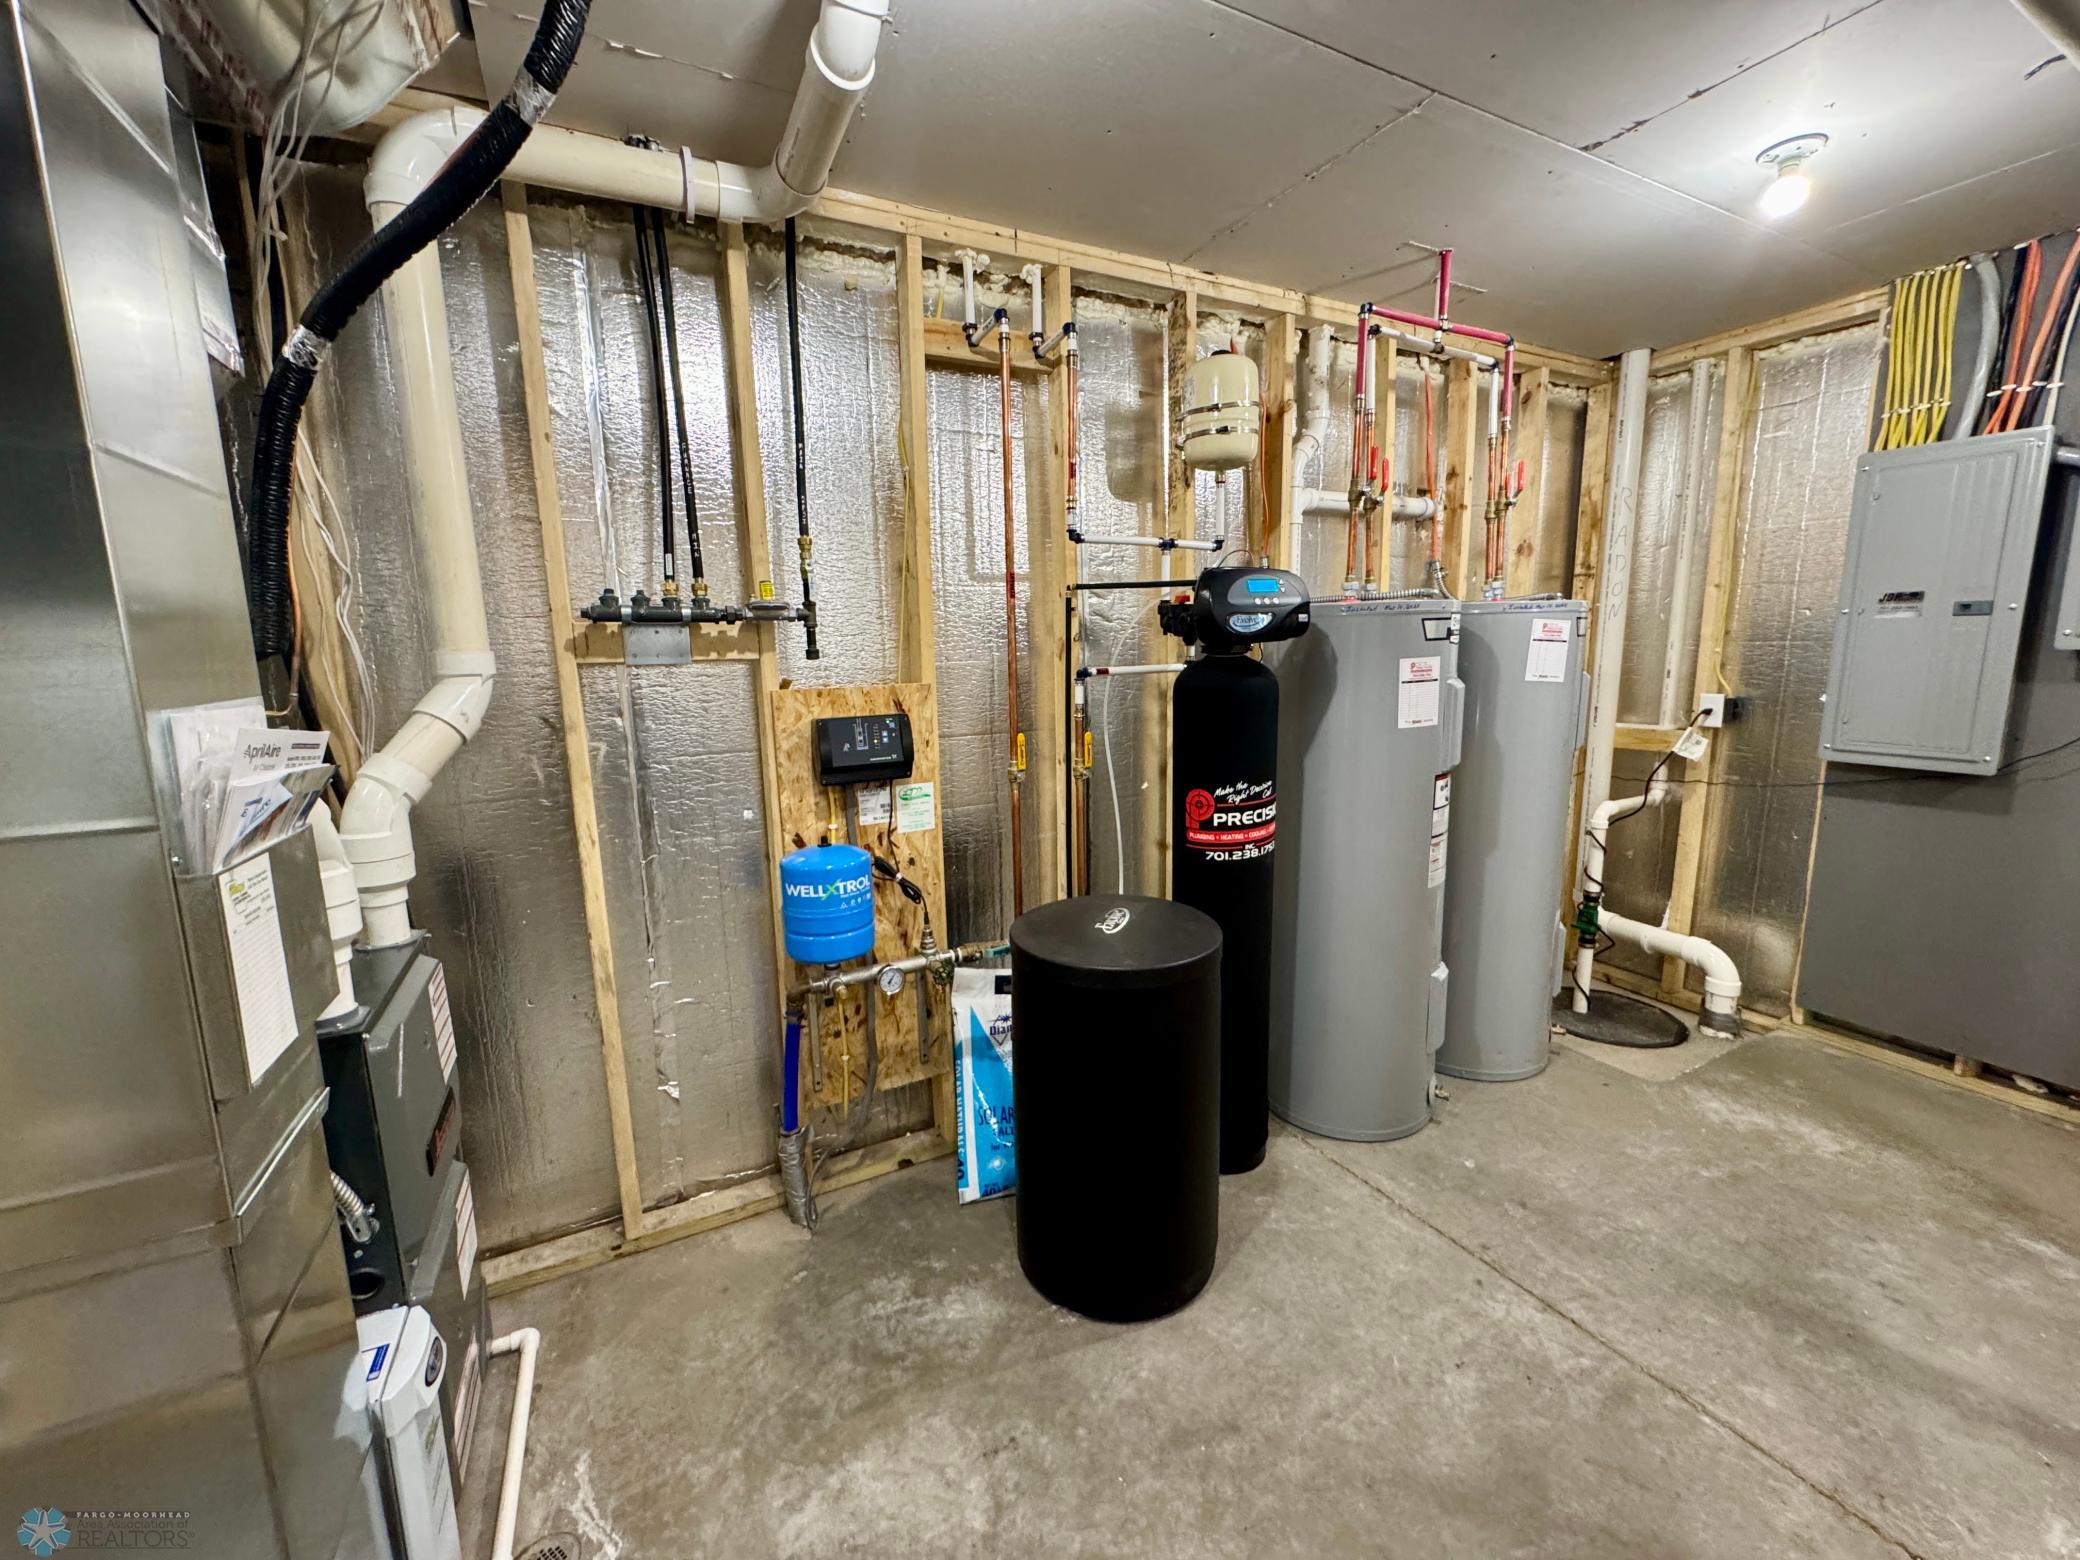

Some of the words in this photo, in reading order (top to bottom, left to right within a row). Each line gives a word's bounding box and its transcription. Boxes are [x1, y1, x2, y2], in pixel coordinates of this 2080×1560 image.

[1608, 486, 1633, 620] RADON
[243, 743, 281, 764] AprilAire
[1214, 784, 1234, 798] Make
[1235, 780, 1248, 791] the
[1226, 789, 1249, 805] Right
[1220, 833, 1244, 841] HEATING
